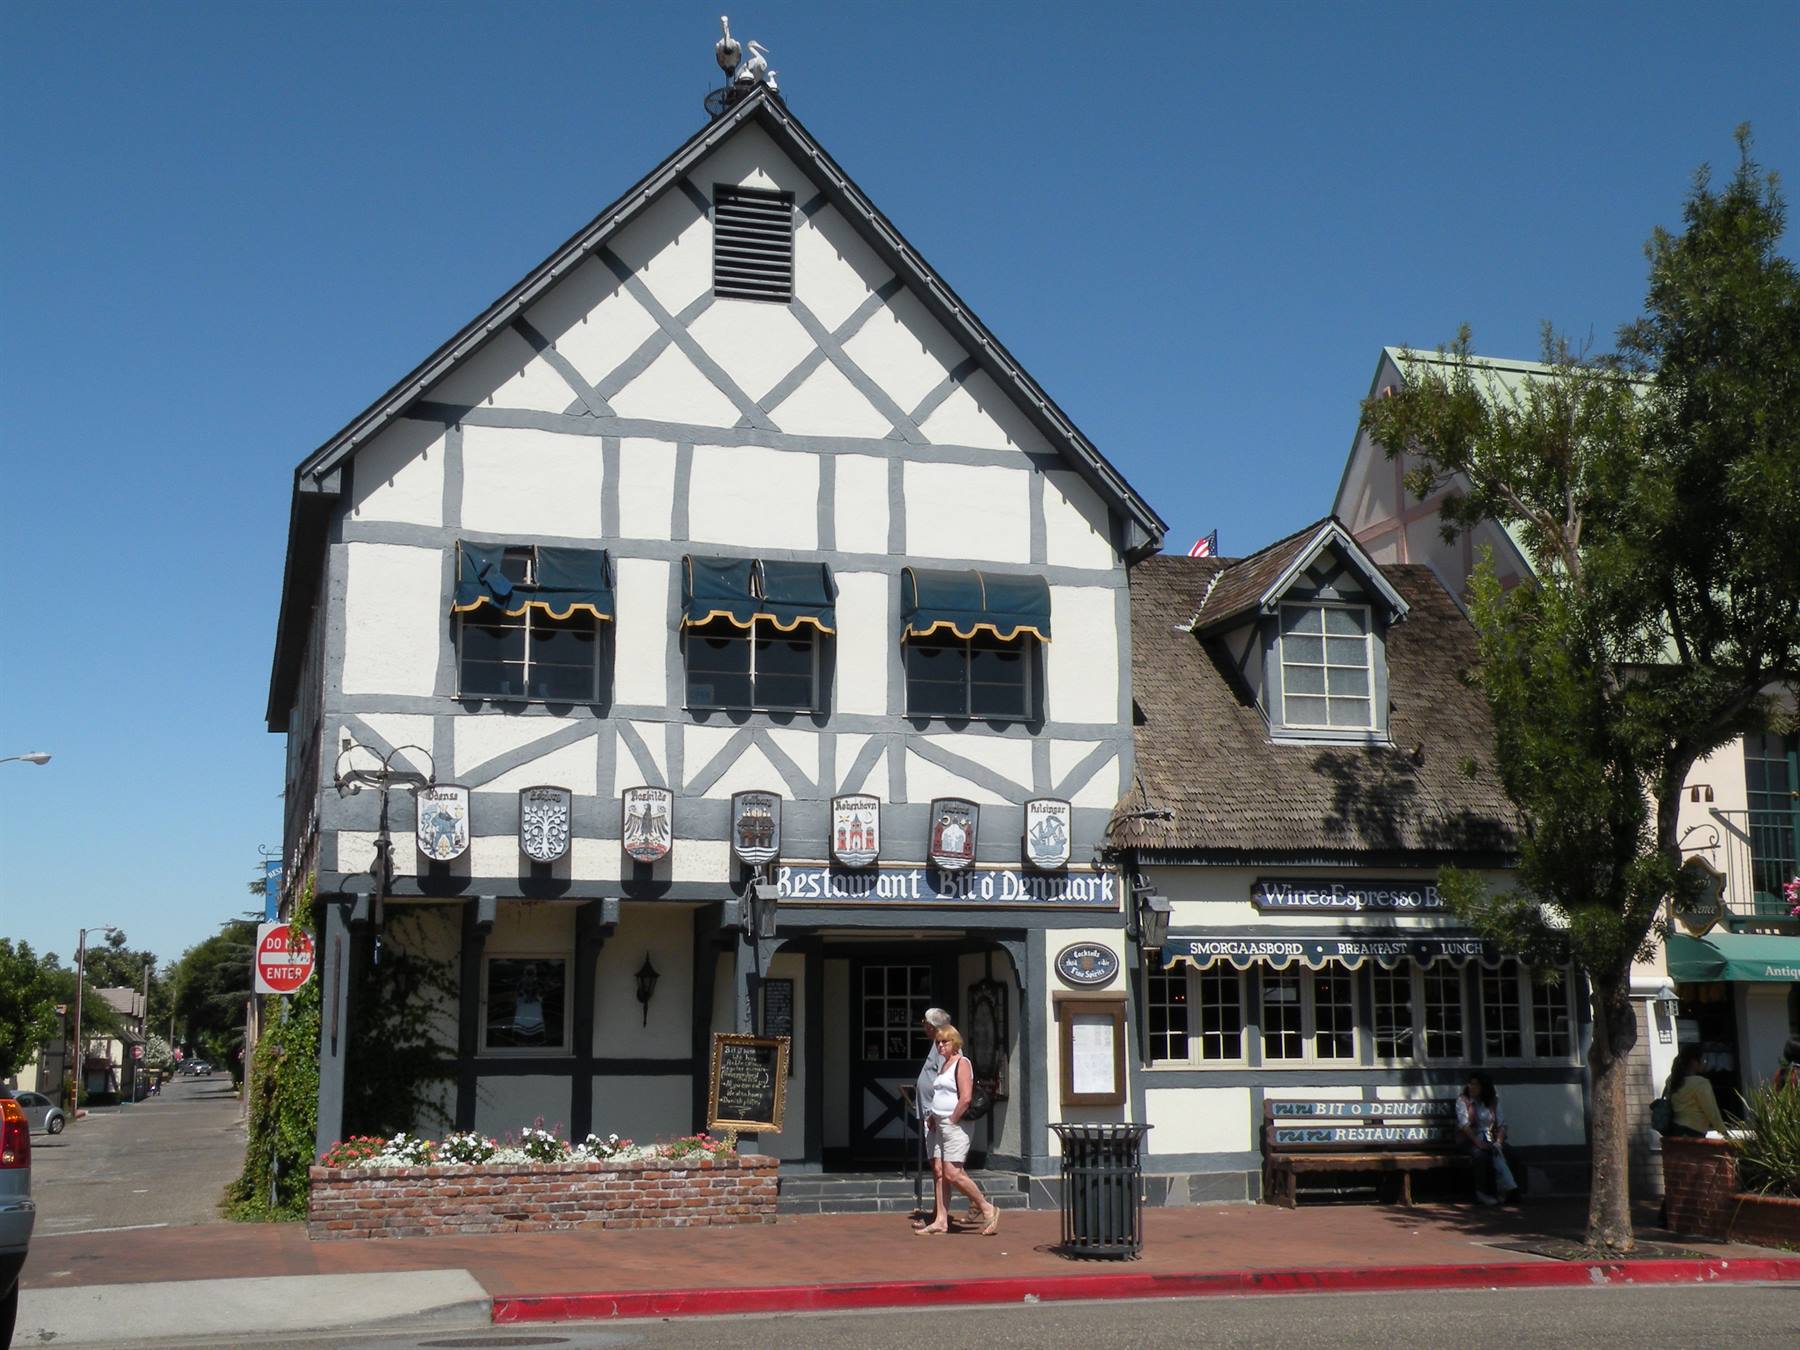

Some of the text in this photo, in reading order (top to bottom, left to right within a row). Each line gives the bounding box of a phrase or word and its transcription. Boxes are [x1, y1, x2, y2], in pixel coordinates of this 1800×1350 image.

[777, 866, 922, 898] Restaurant
[936, 870, 977, 900] Bit
[1000, 870, 1113, 901] Denmark
[266, 937, 282, 950] DO
[1190, 942, 1483, 955] SMORGAASBORD BREAKFAST LUNCH
[1073, 949, 1100, 958] Cocktails
[267, 967, 303, 980] ENTER
[1315, 1103, 1447, 1116] BIT O DENMARK
